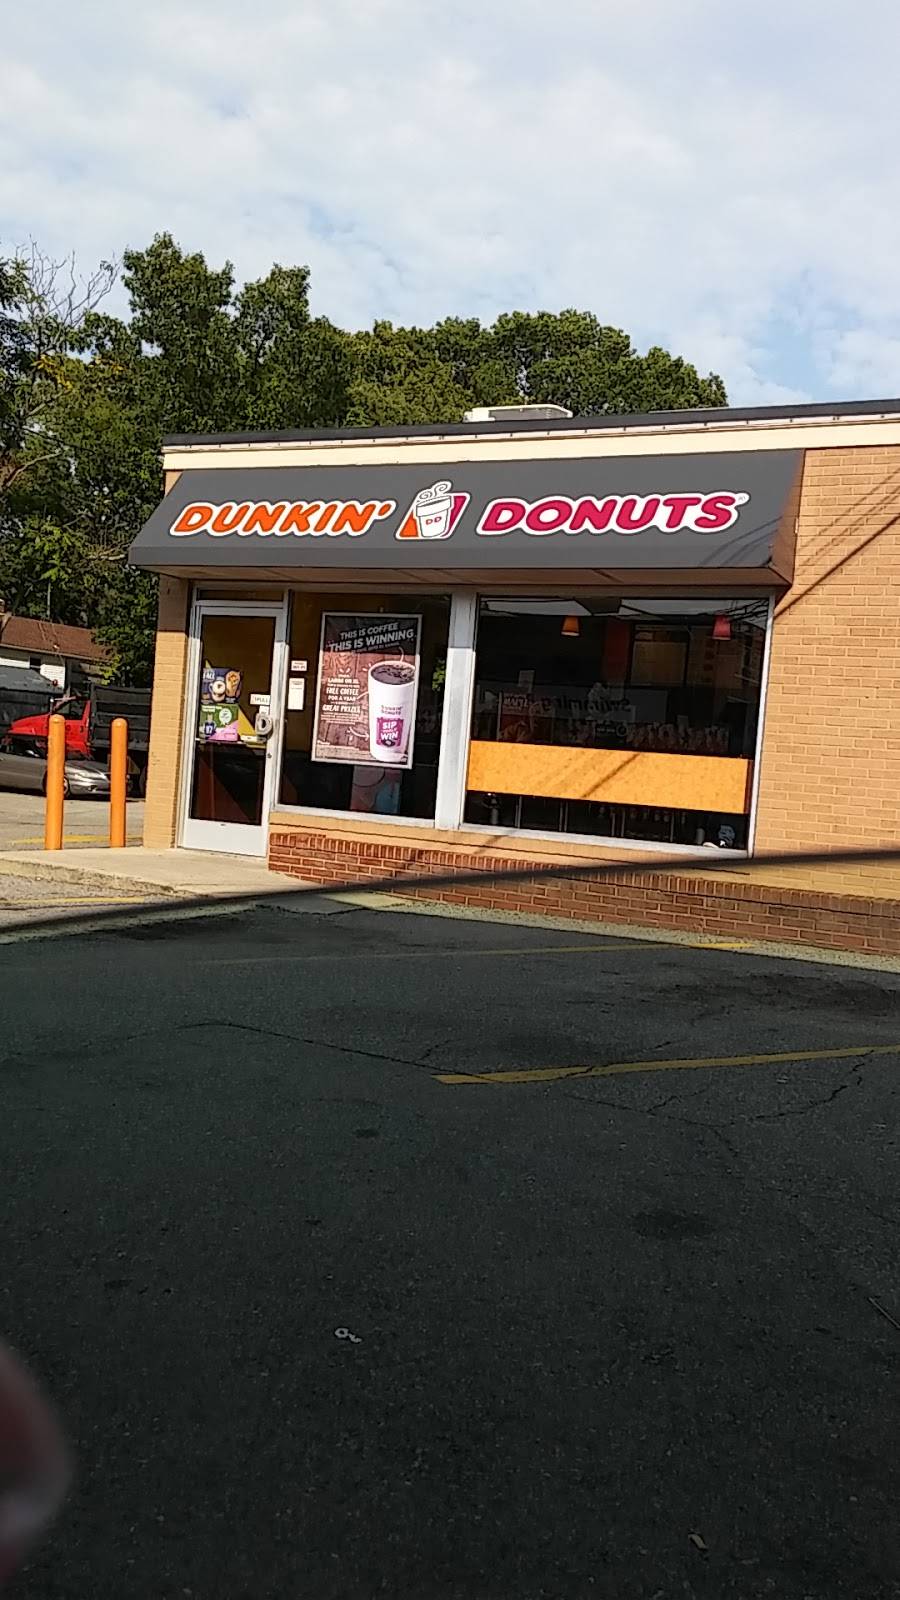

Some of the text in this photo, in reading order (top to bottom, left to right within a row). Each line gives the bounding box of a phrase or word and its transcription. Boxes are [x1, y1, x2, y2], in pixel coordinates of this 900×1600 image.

[171, 494, 737, 535] DUNKIN' DONUTS
[425, 516, 442, 525] DD
[340, 622, 398, 640] THIS IS COFFEE
[329, 641, 352, 652] THIS
[354, 638, 363, 648] IS
[382, 721, 398, 730] SIP
[381, 731, 399, 741] WIN
